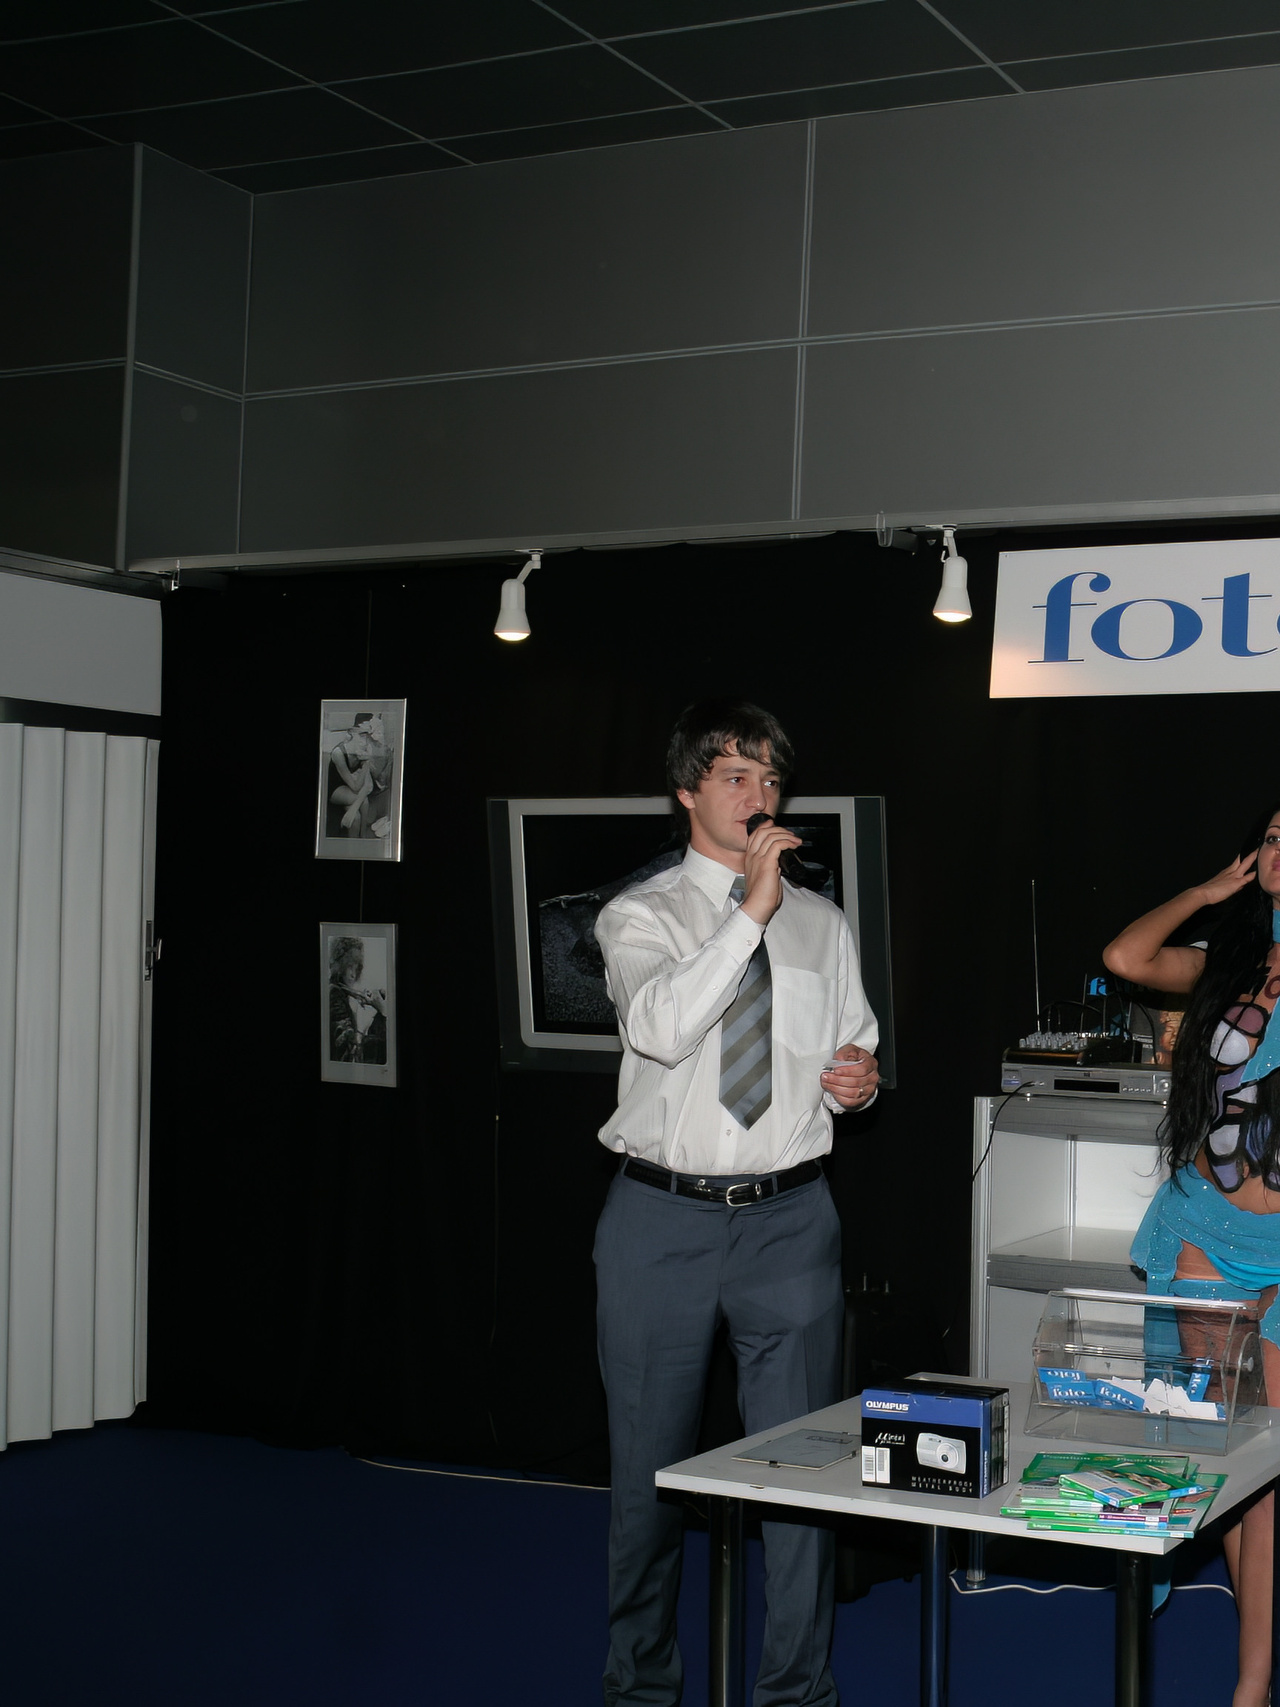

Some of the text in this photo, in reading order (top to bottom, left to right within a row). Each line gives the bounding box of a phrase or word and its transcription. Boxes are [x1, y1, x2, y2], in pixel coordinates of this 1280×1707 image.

[1053, 1387, 1086, 1397] foto
[865, 1400, 909, 1411] OLYMPUS
[911, 1476, 973, 1487] WEATHERPROOF
